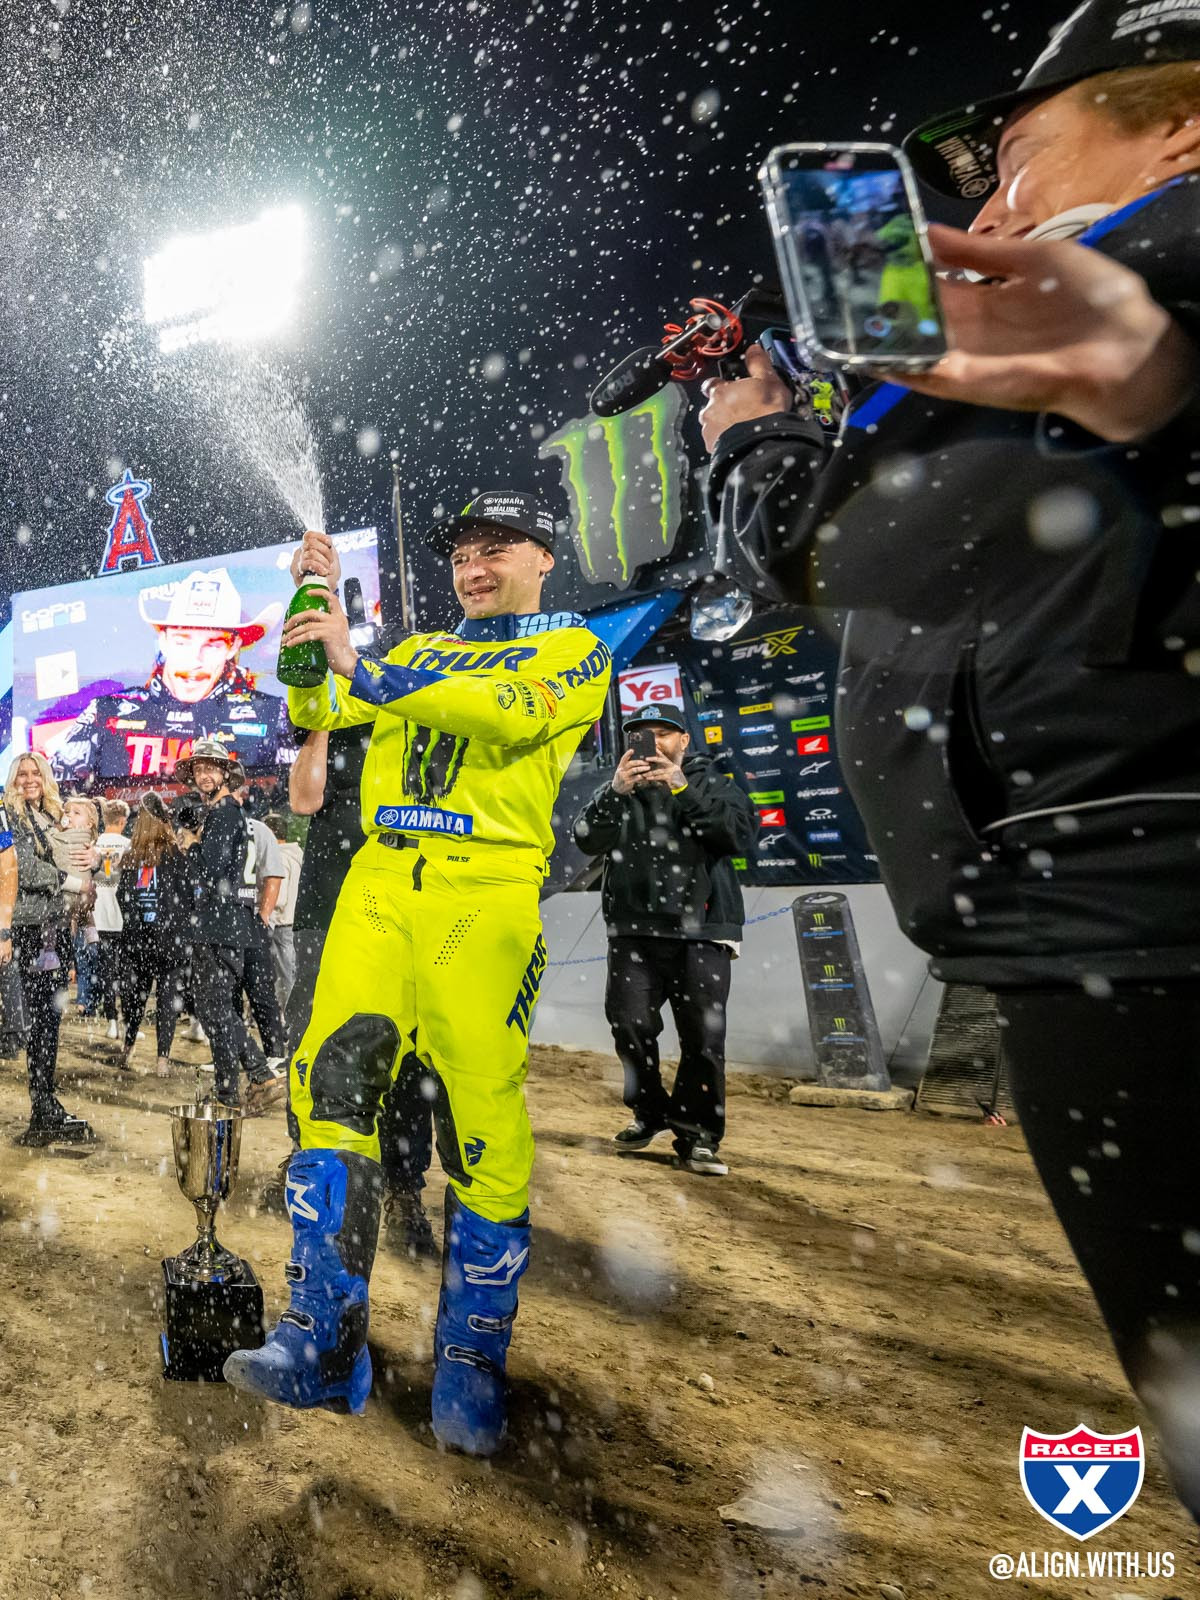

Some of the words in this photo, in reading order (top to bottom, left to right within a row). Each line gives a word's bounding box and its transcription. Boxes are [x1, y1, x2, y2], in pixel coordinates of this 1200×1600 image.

[493, 498, 524, 506] YAMAHA
[731, 632, 798, 661] SMX
[400, 809, 465, 834] YAMAHA
[446, 855, 471, 863] PULSE
